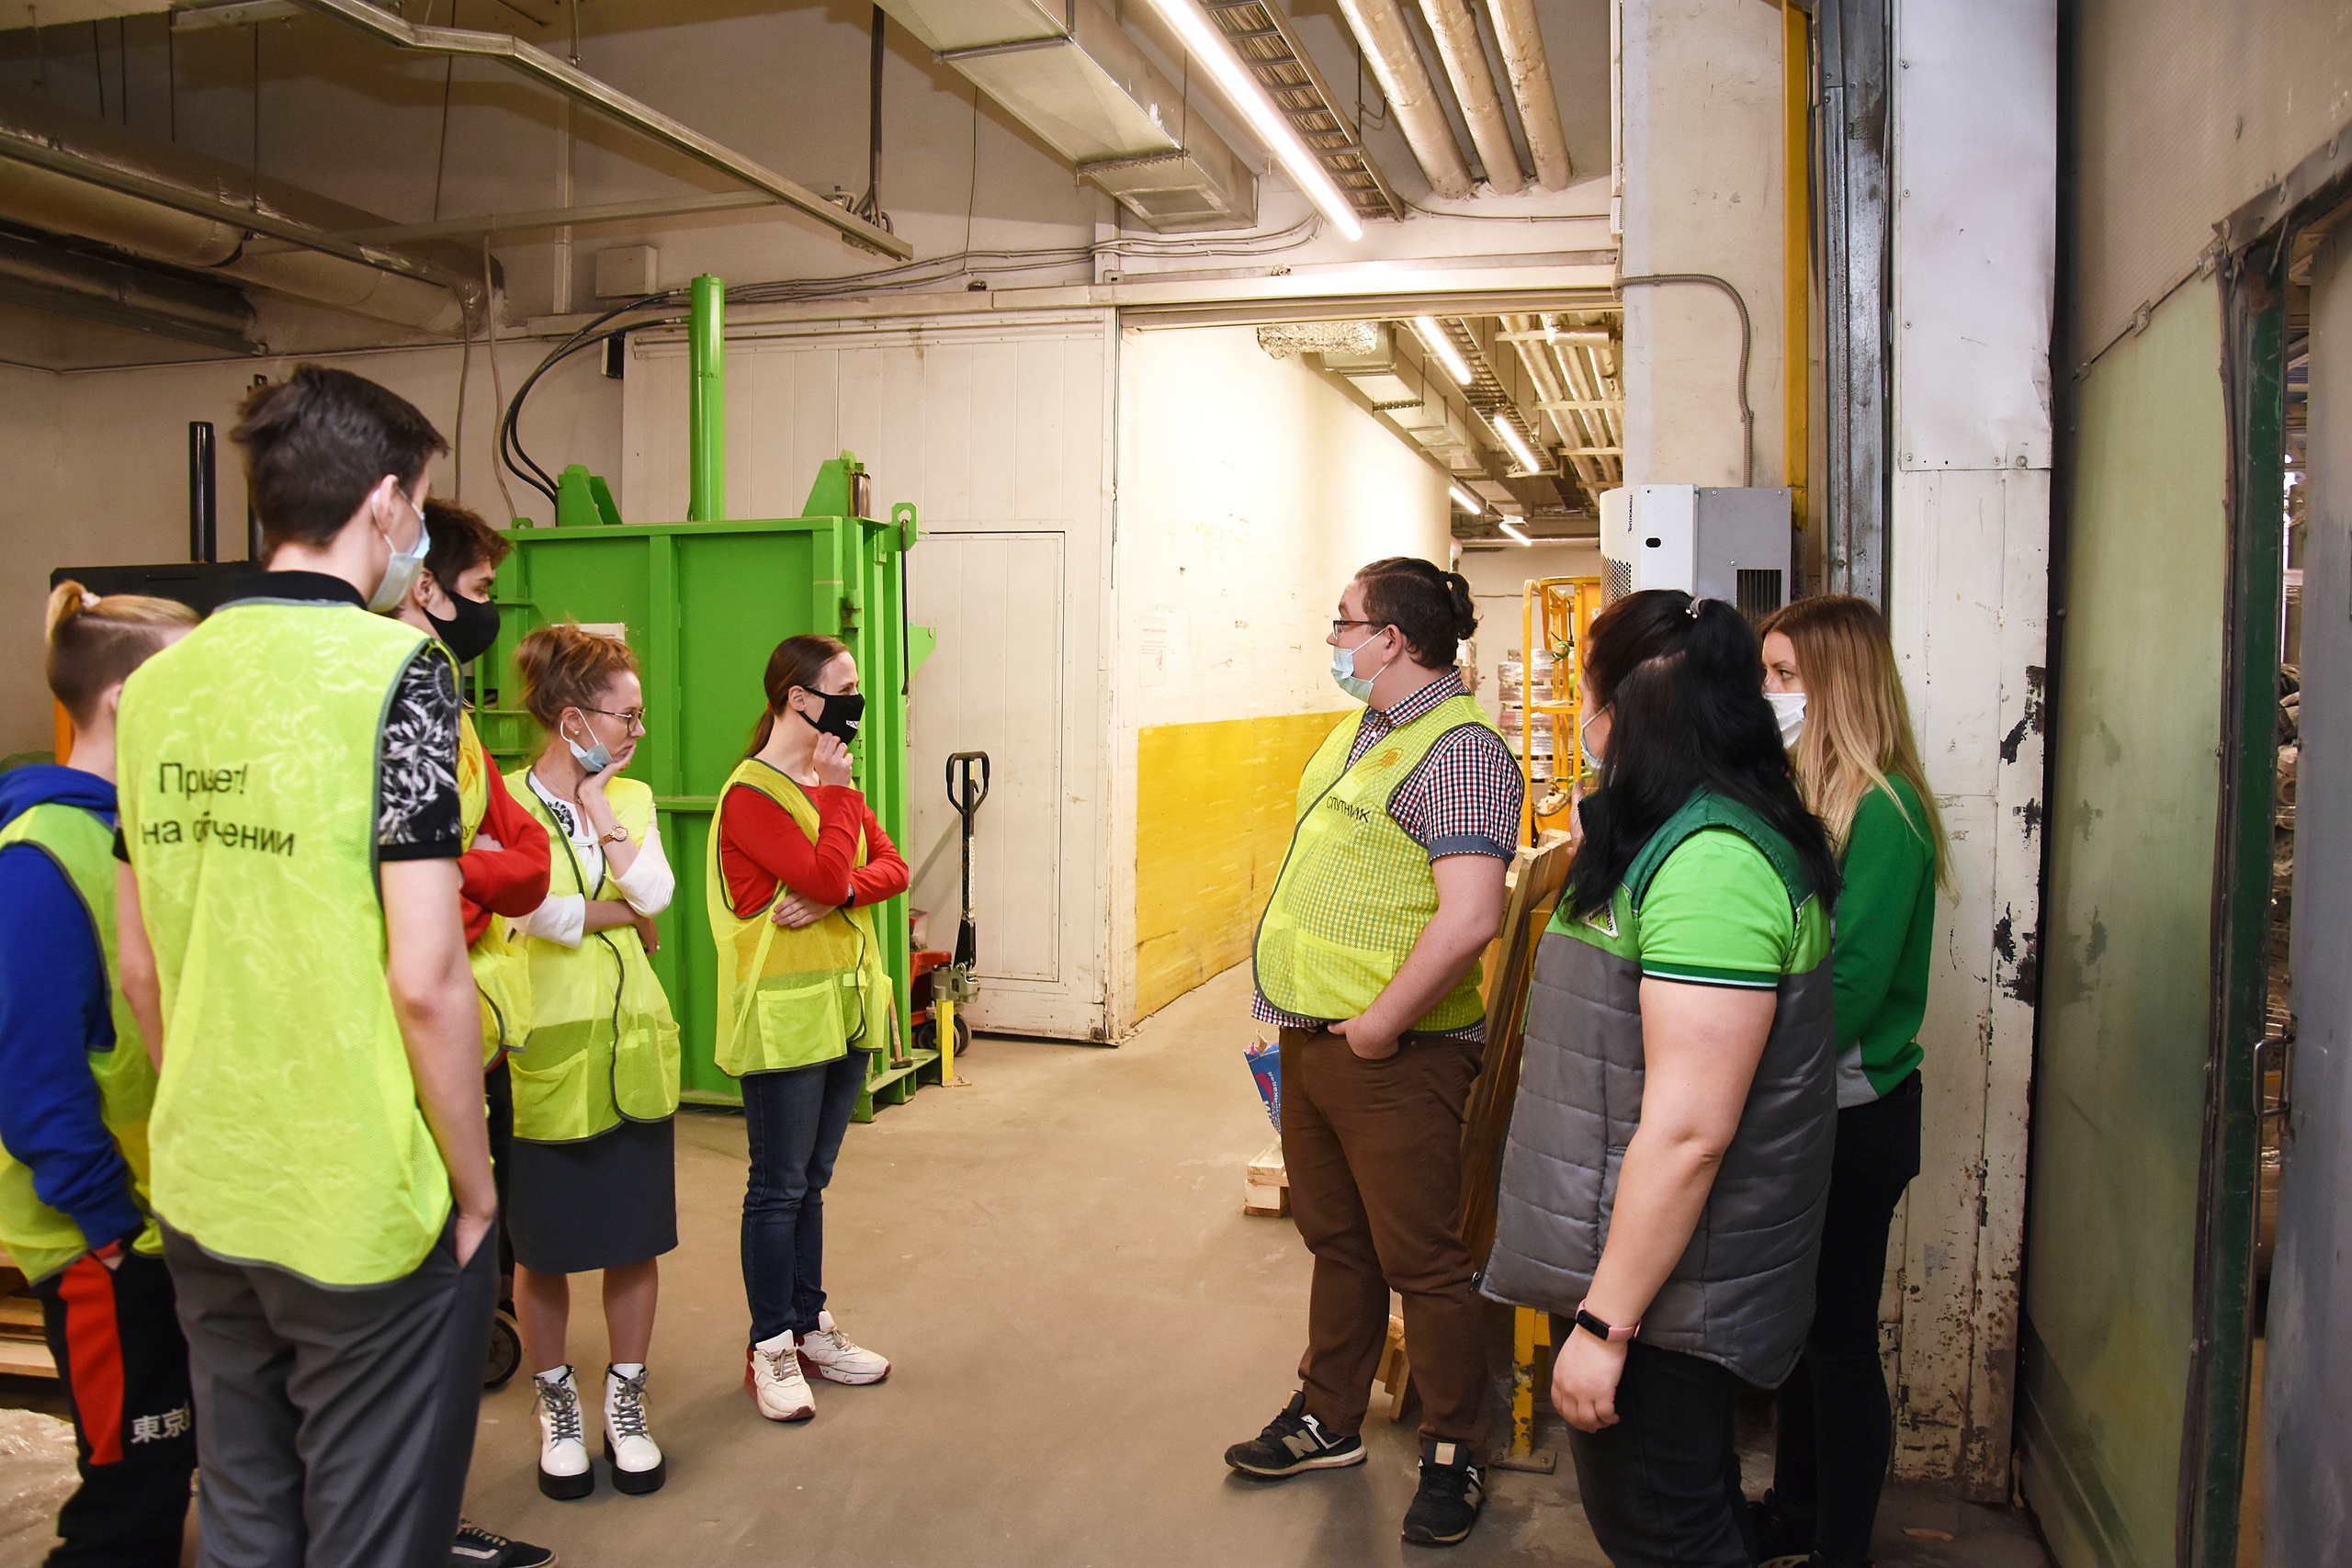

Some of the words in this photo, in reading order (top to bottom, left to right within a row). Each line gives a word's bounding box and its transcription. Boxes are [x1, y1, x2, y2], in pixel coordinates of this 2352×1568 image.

[1326, 795, 1372, 823] СПУТНИК
[142, 819, 182, 845] на
[192, 811, 295, 856] обчении
